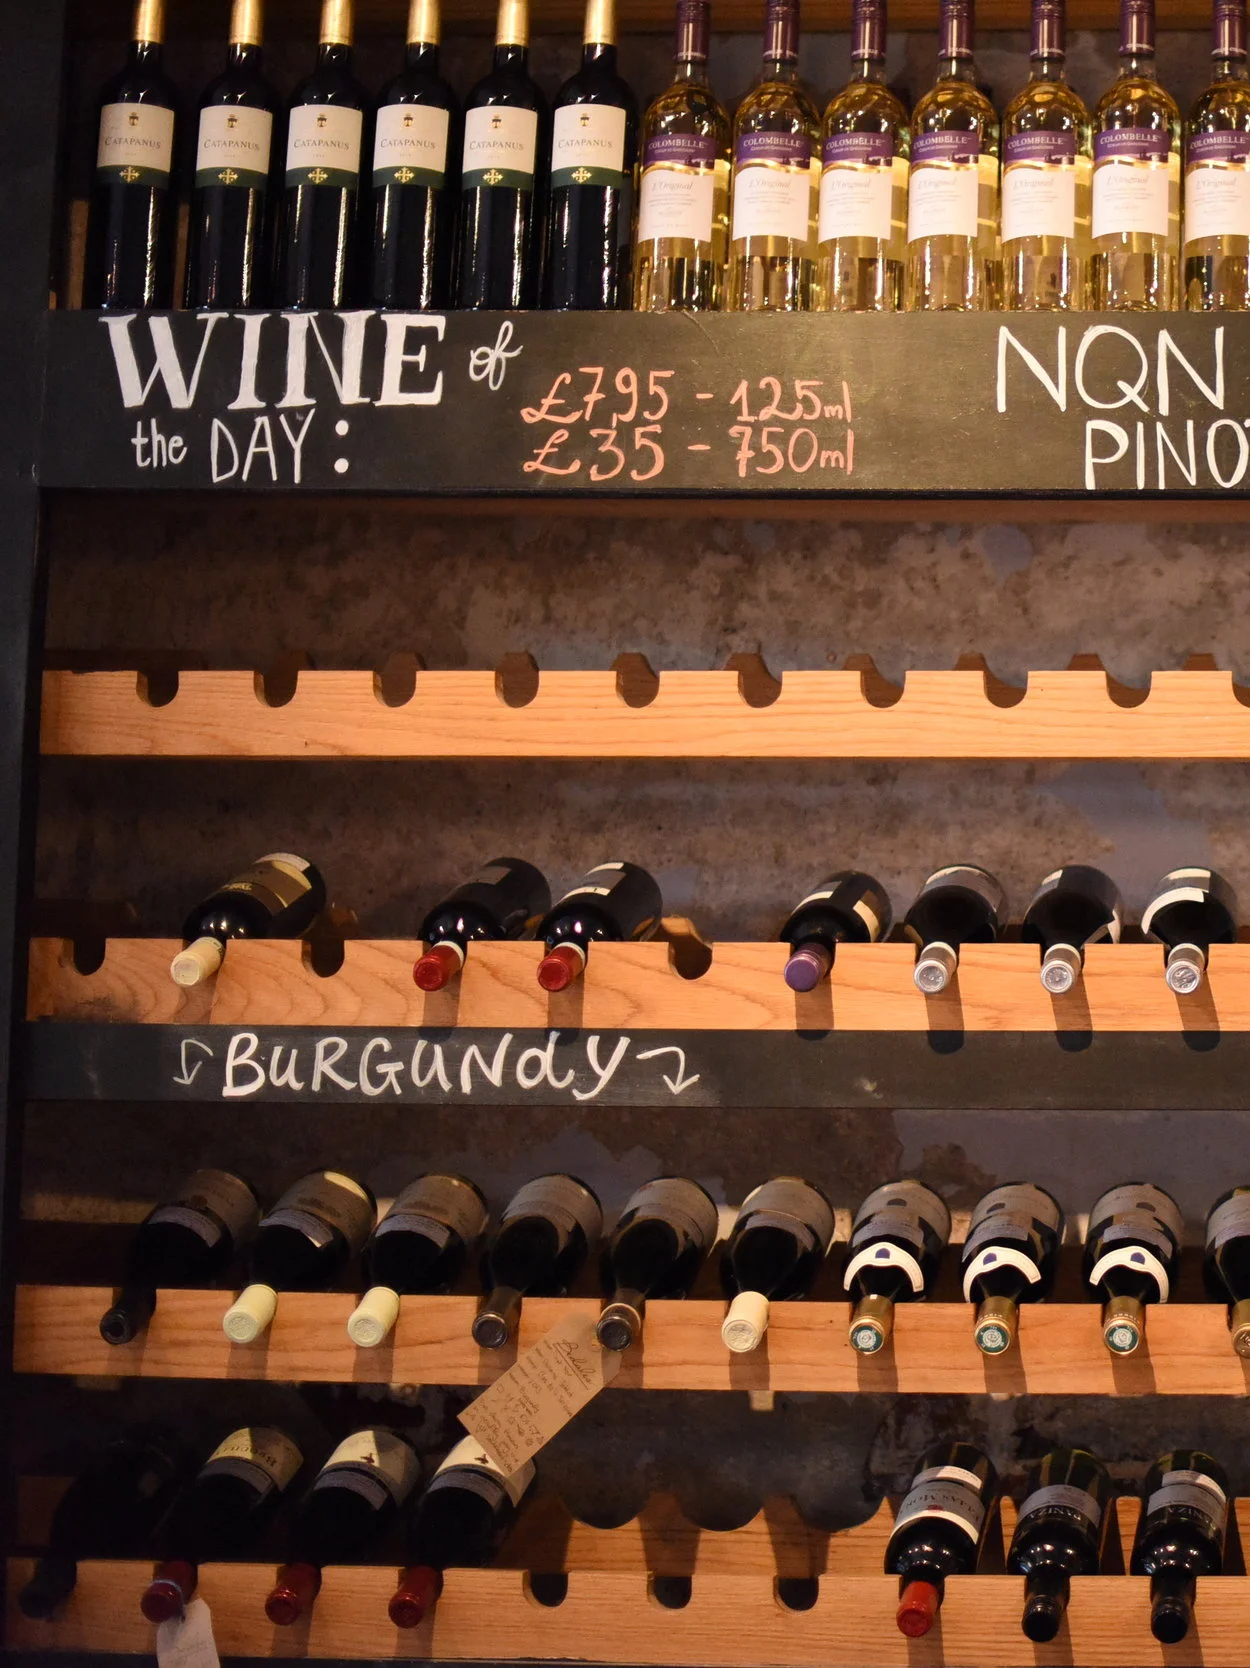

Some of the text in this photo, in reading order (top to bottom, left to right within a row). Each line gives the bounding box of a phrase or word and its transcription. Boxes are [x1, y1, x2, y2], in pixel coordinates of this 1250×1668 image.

[105, 136, 161, 149] CATAPANUS
[204, 138, 260, 150] CATAPANUS
[294, 138, 350, 150] CATAPANUS
[381, 138, 436, 150] CATAPANUS
[470, 140, 524, 151] CATAPANUS
[558, 138, 613, 149] CATAPANUS
[648, 138, 705, 149] COLOMBELLE
[743, 136, 801, 148] COLOMBELLE
[826, 137, 882, 150] COLOMBELLE
[913, 135, 968, 149] COLOMBELLE
[1007, 136, 1064, 149] COLOMBELLE
[1100, 133, 1158, 145] COLOMBELLE
[101, 313, 523, 409] WINE of
[997, 325, 1224, 413] NQN
[730, 377, 852, 423] 125ml
[131, 418, 187, 467] the
[522, 425, 664, 481] £35
[728, 425, 855, 478] 750ml
[1028, 1506, 1082, 1521] PANIZA
